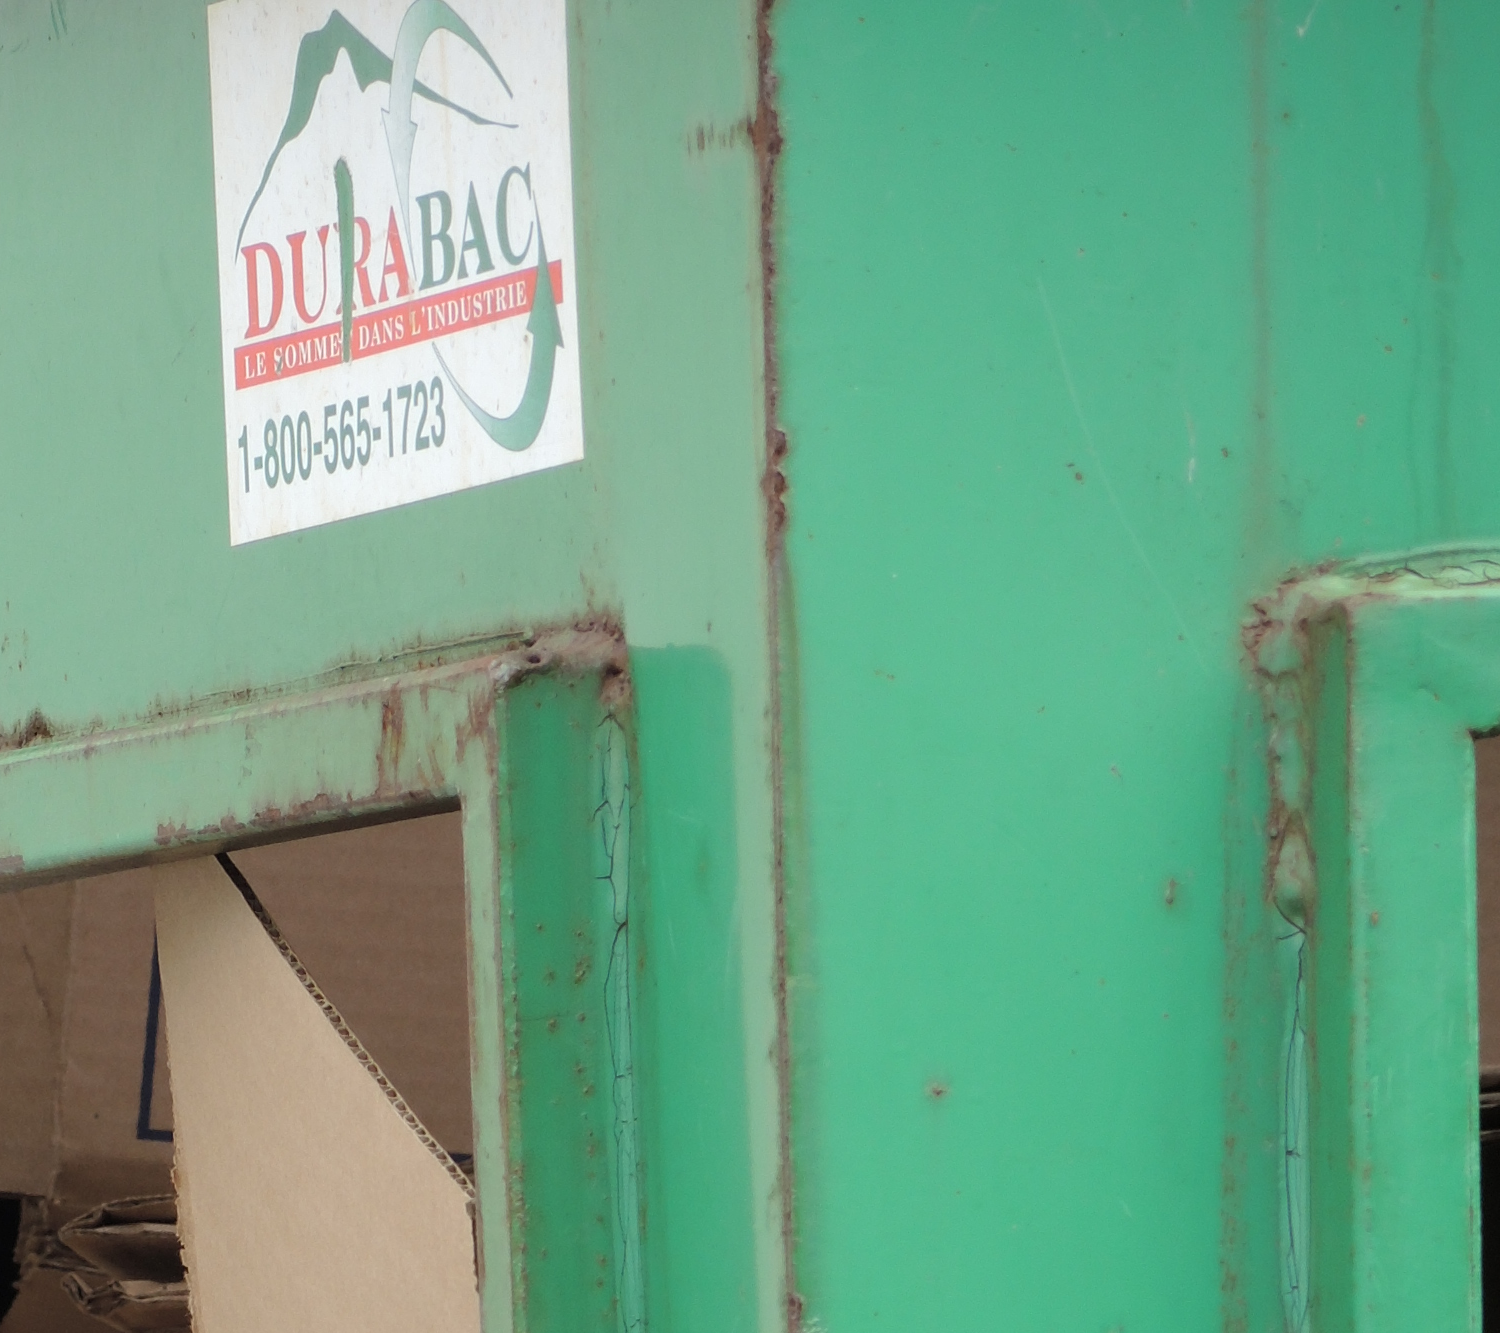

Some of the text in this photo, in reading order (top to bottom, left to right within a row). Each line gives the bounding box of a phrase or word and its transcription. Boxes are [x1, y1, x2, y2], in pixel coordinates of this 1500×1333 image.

[241, 162, 534, 339] DURABAC
[245, 284, 527, 379] LE SOMME DANS L'INDUSTRIE
[238, 376, 446, 493] 1-800-565-1723
